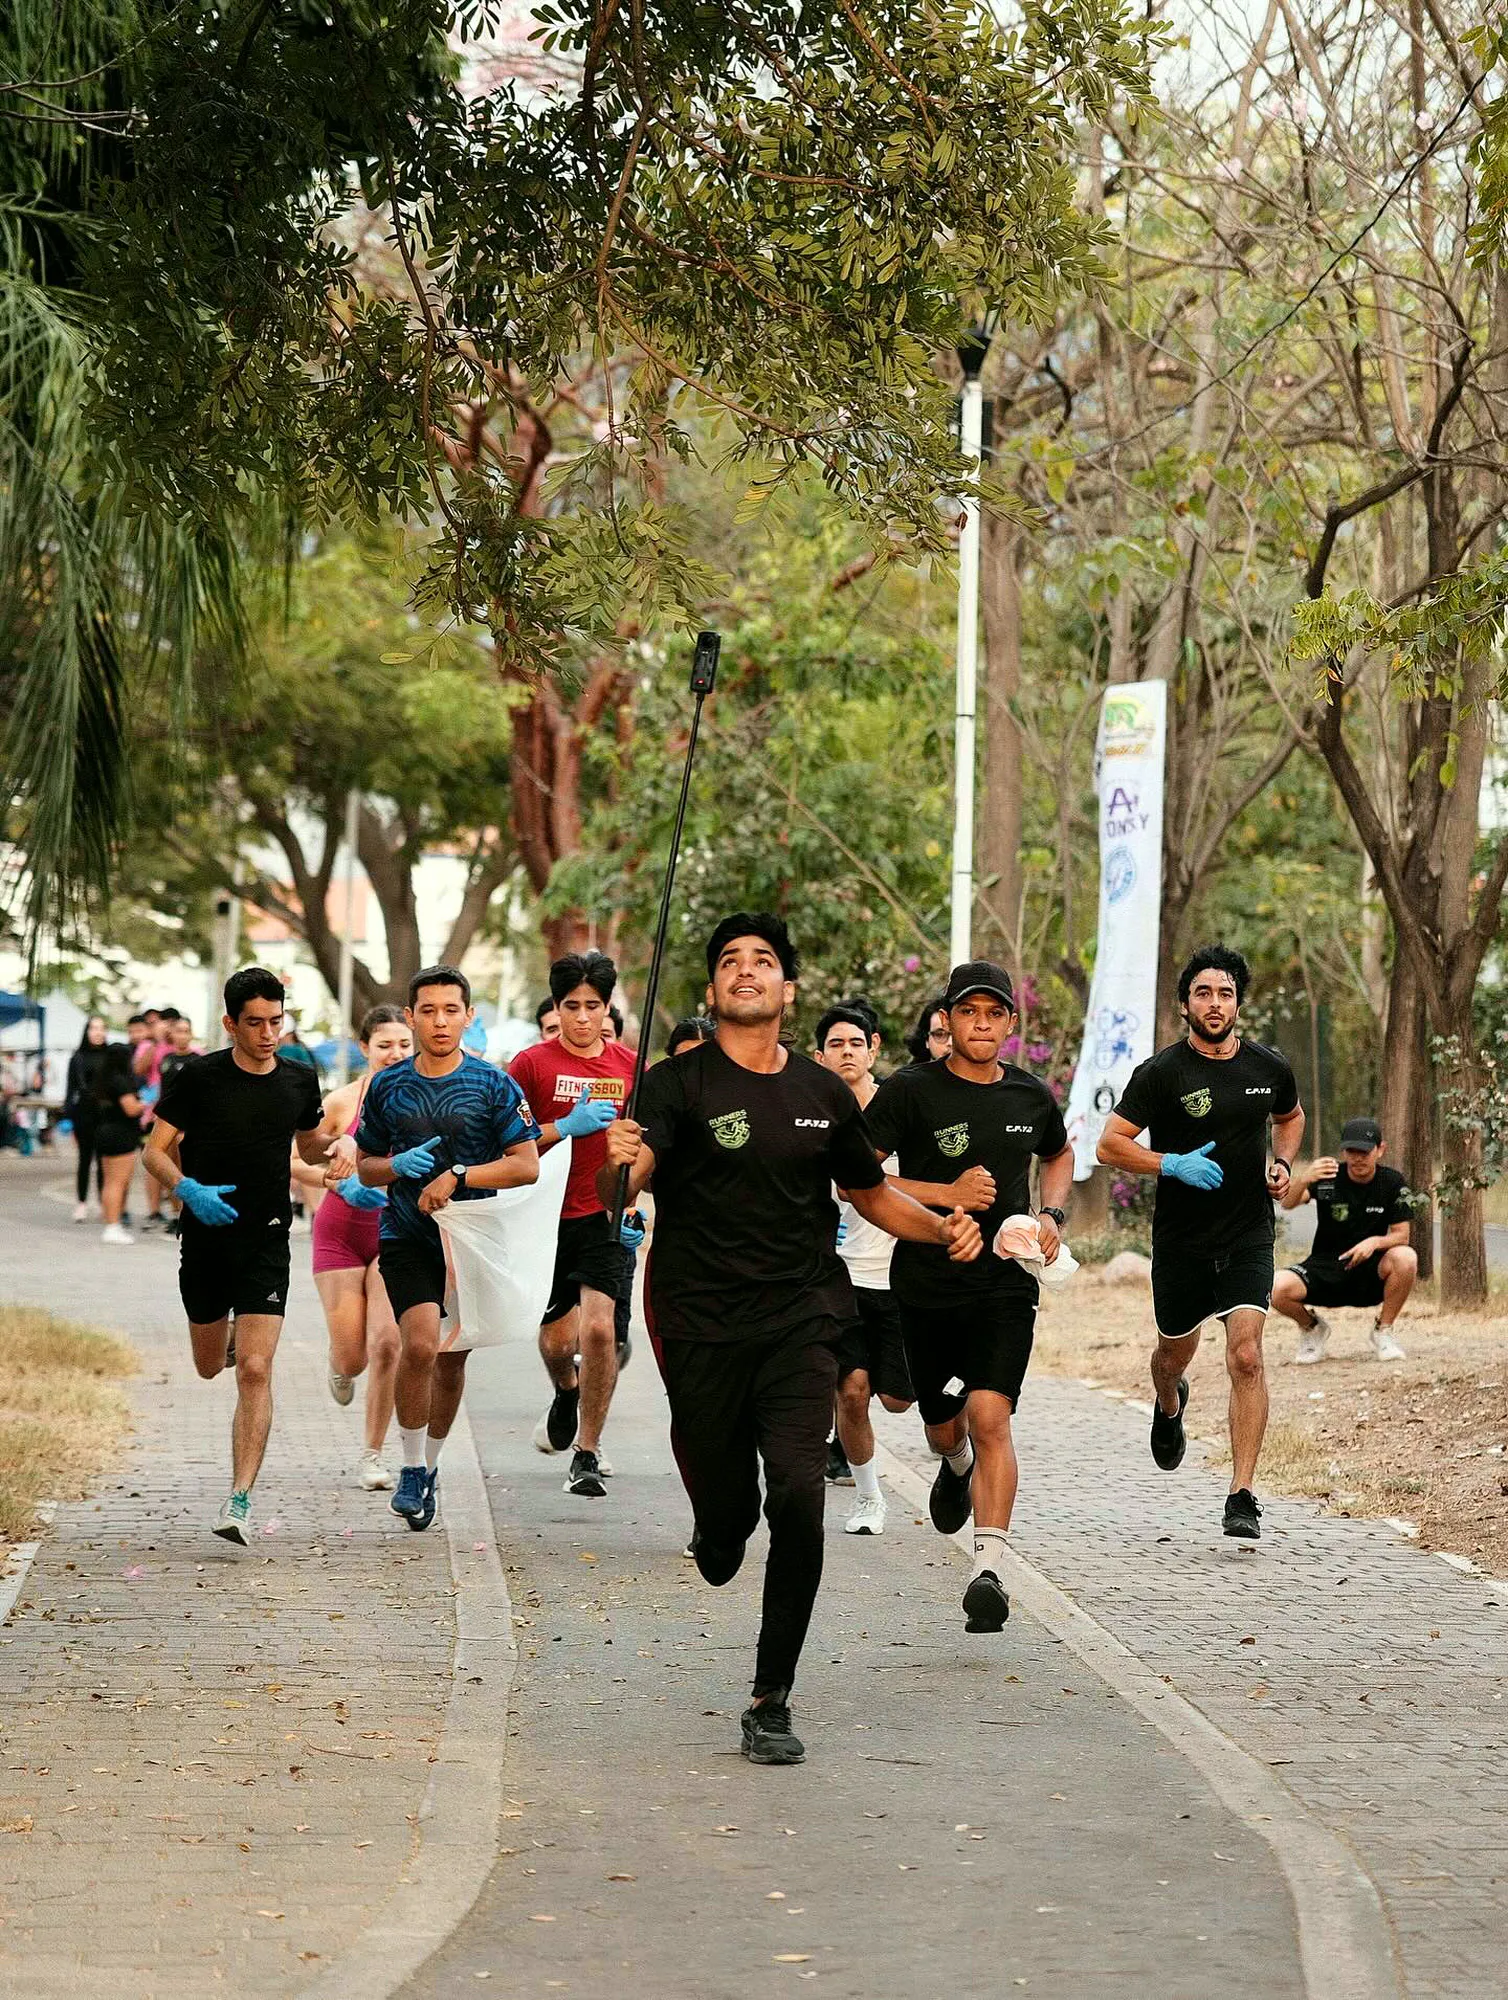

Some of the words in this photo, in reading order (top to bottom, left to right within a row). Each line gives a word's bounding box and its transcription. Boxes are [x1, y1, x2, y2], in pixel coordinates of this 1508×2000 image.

[557, 1079, 624, 1095] FITNESSBOY
[708, 1109, 747, 1126] RUNNERS
[933, 1121, 969, 1137] RUNNERS
